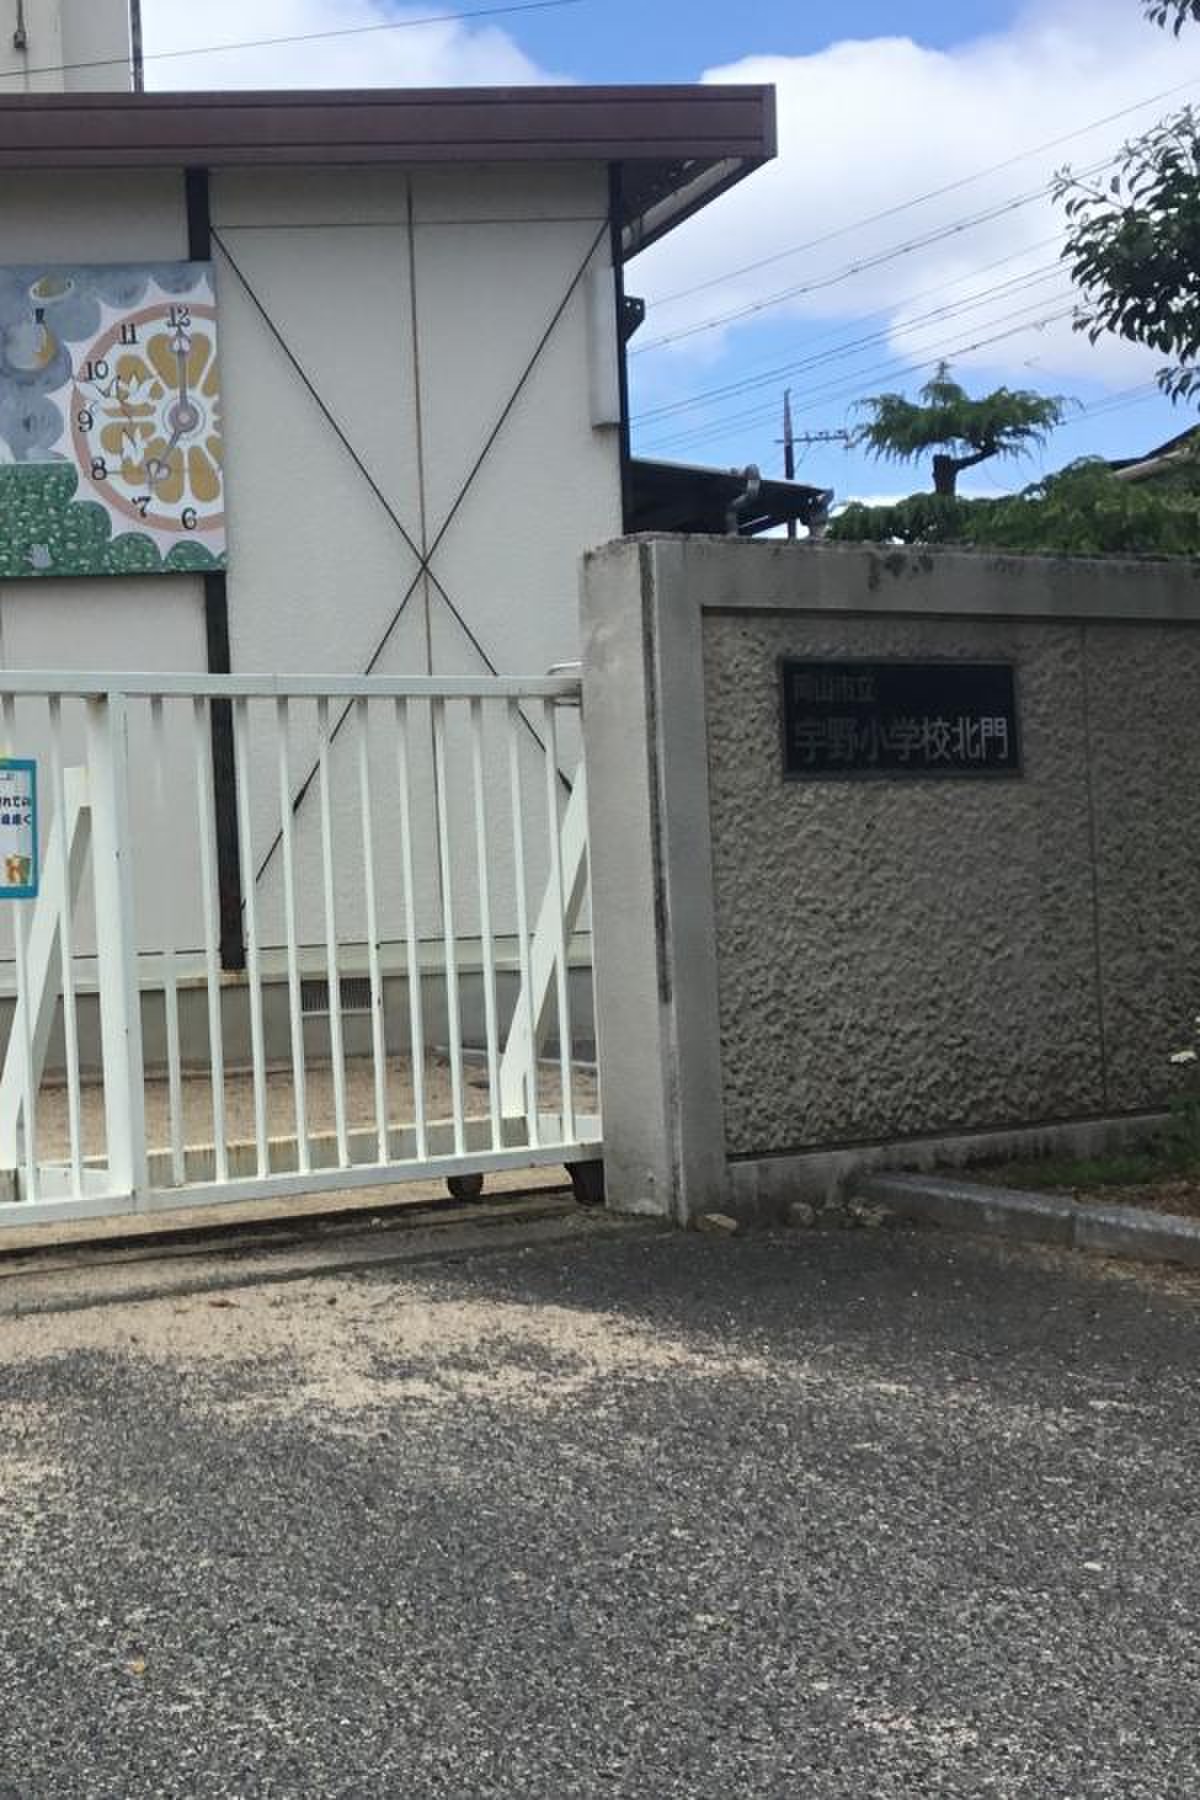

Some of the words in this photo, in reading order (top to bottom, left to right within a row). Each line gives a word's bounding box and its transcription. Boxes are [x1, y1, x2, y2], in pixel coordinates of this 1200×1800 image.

[167, 306, 191, 327] 12
[120, 324, 138, 345] 11
[86, 360, 109, 381] 10
[77, 411, 93, 432] 9
[91, 457, 107, 481] 8
[132, 496, 150, 518] 7
[181, 508, 197, 530] 6
[794, 716, 1009, 761] 宇野小学校北門
